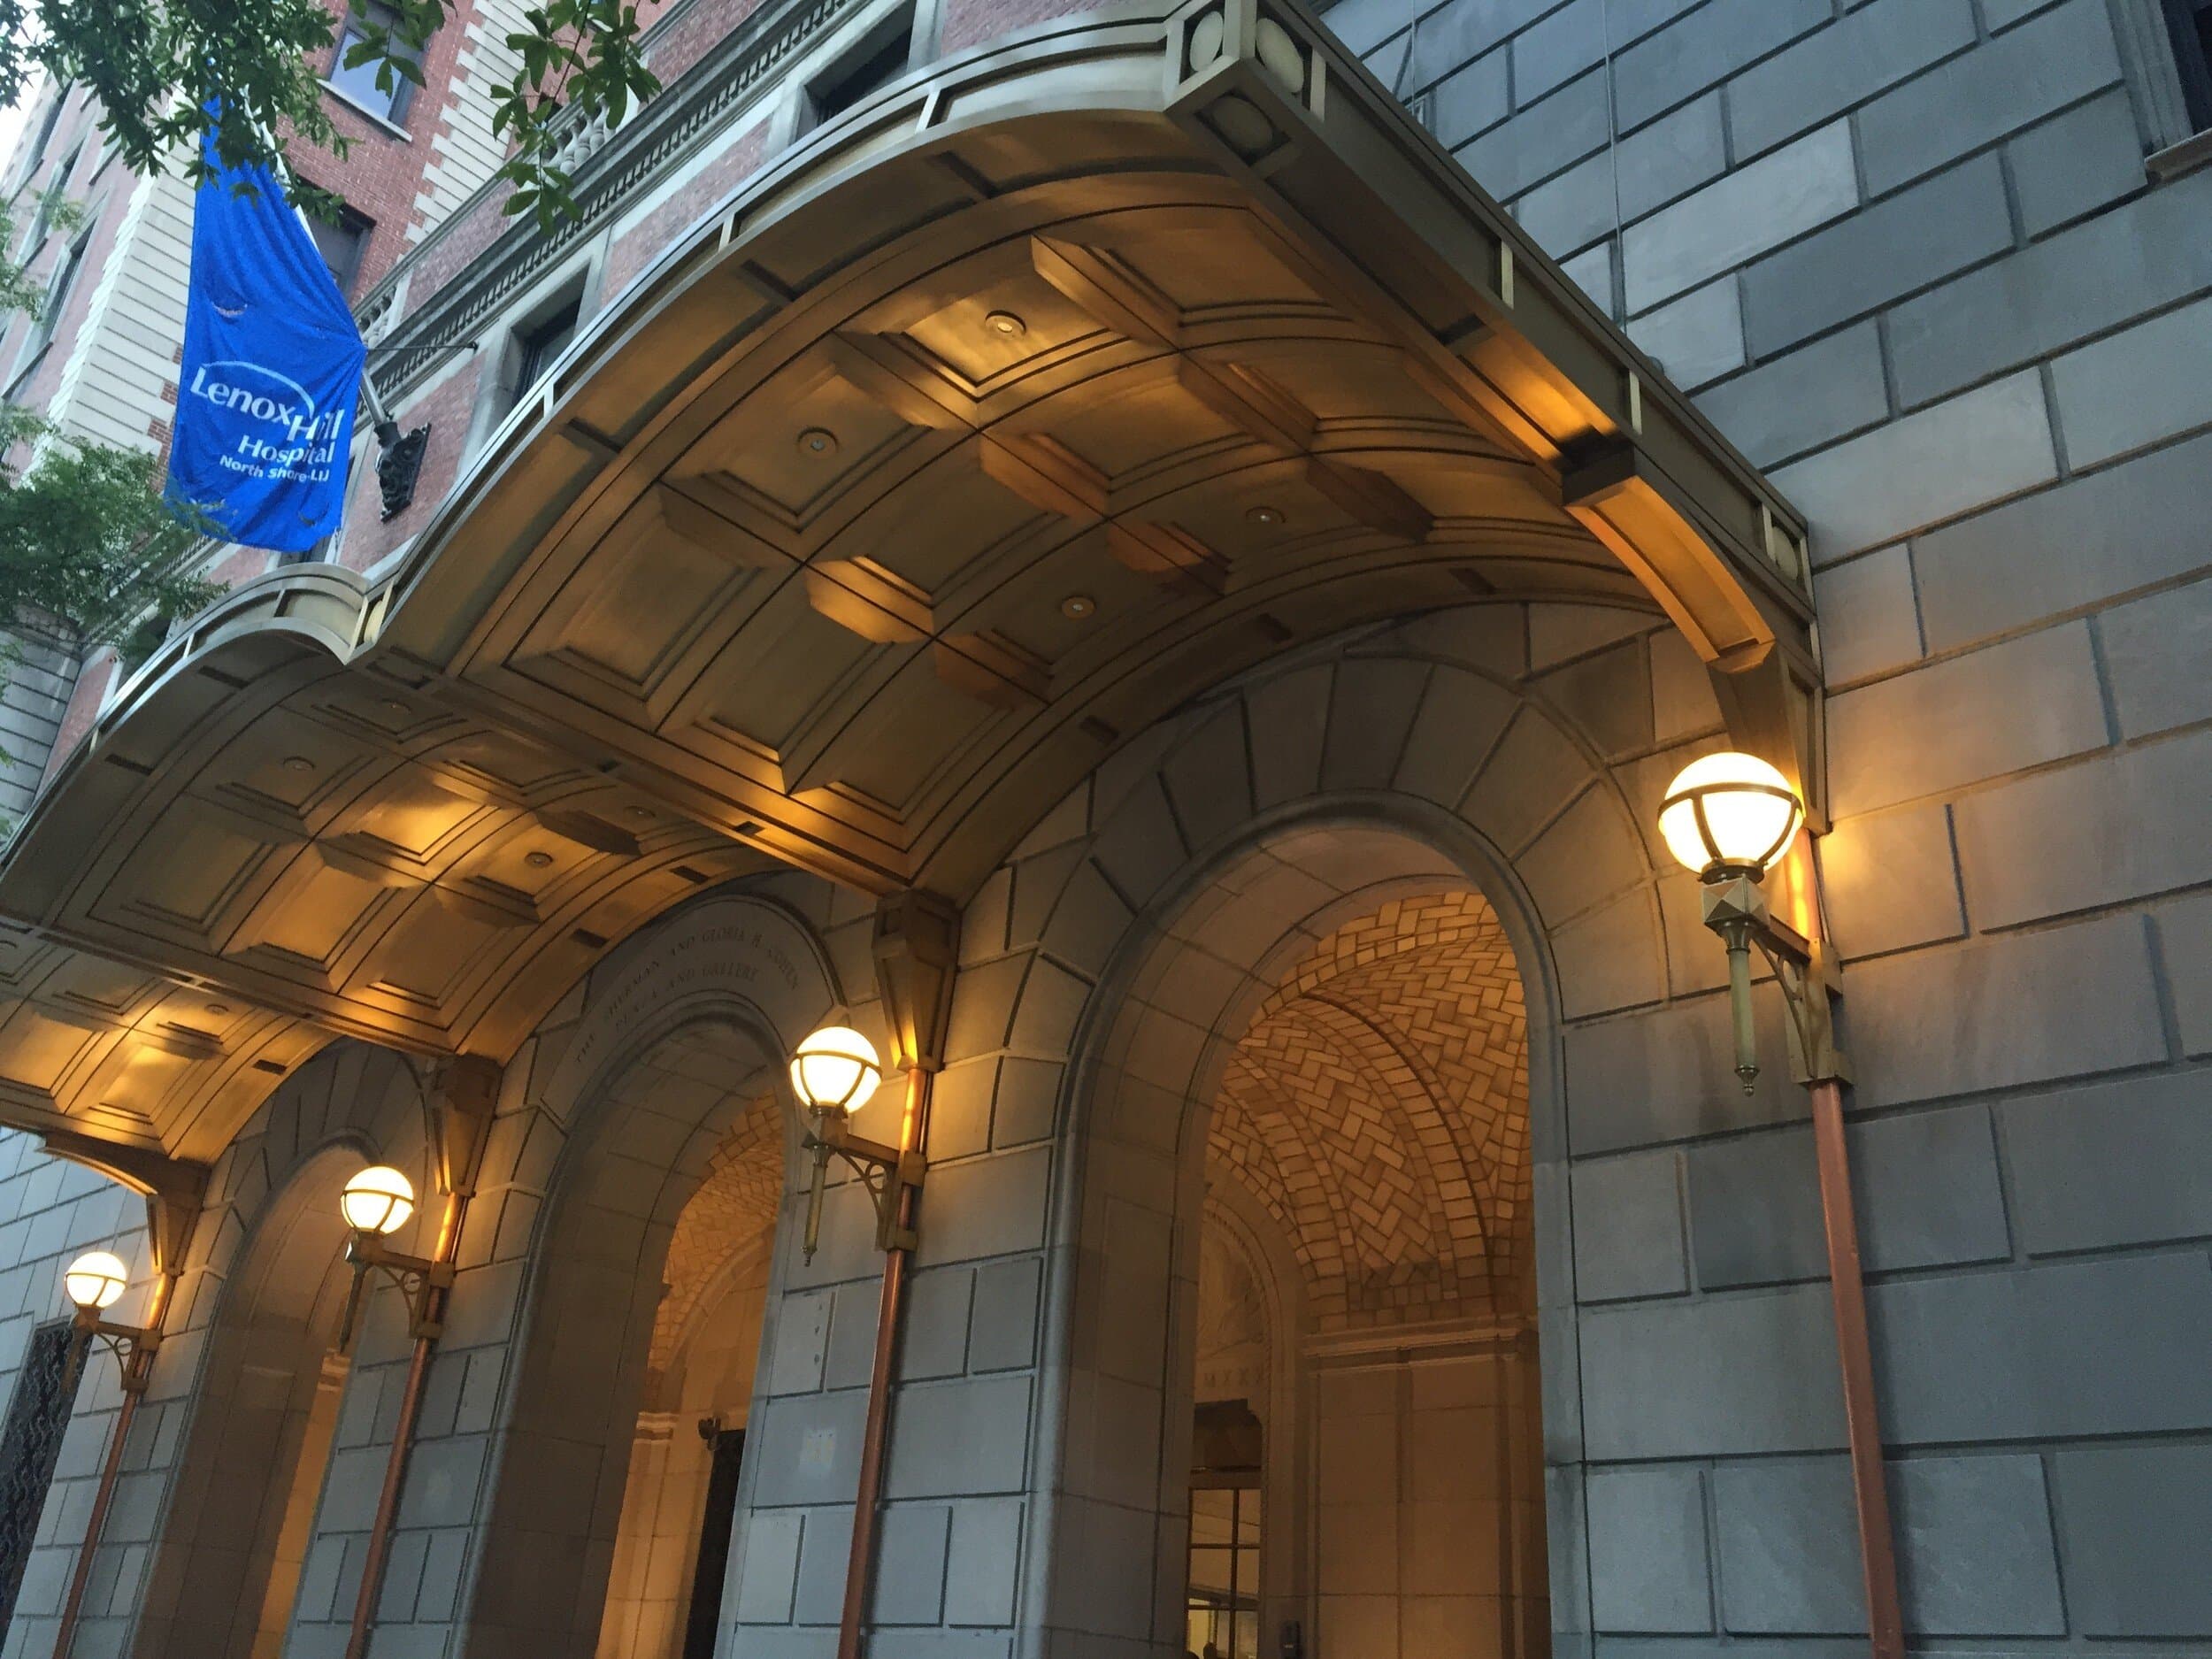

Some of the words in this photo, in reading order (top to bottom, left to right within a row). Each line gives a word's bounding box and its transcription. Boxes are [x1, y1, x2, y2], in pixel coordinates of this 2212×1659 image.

[190, 366, 296, 426] Lenox
[287, 409, 345, 442] Hill
[219, 455, 264, 478] North
[237, 434, 335, 467] Hospital
